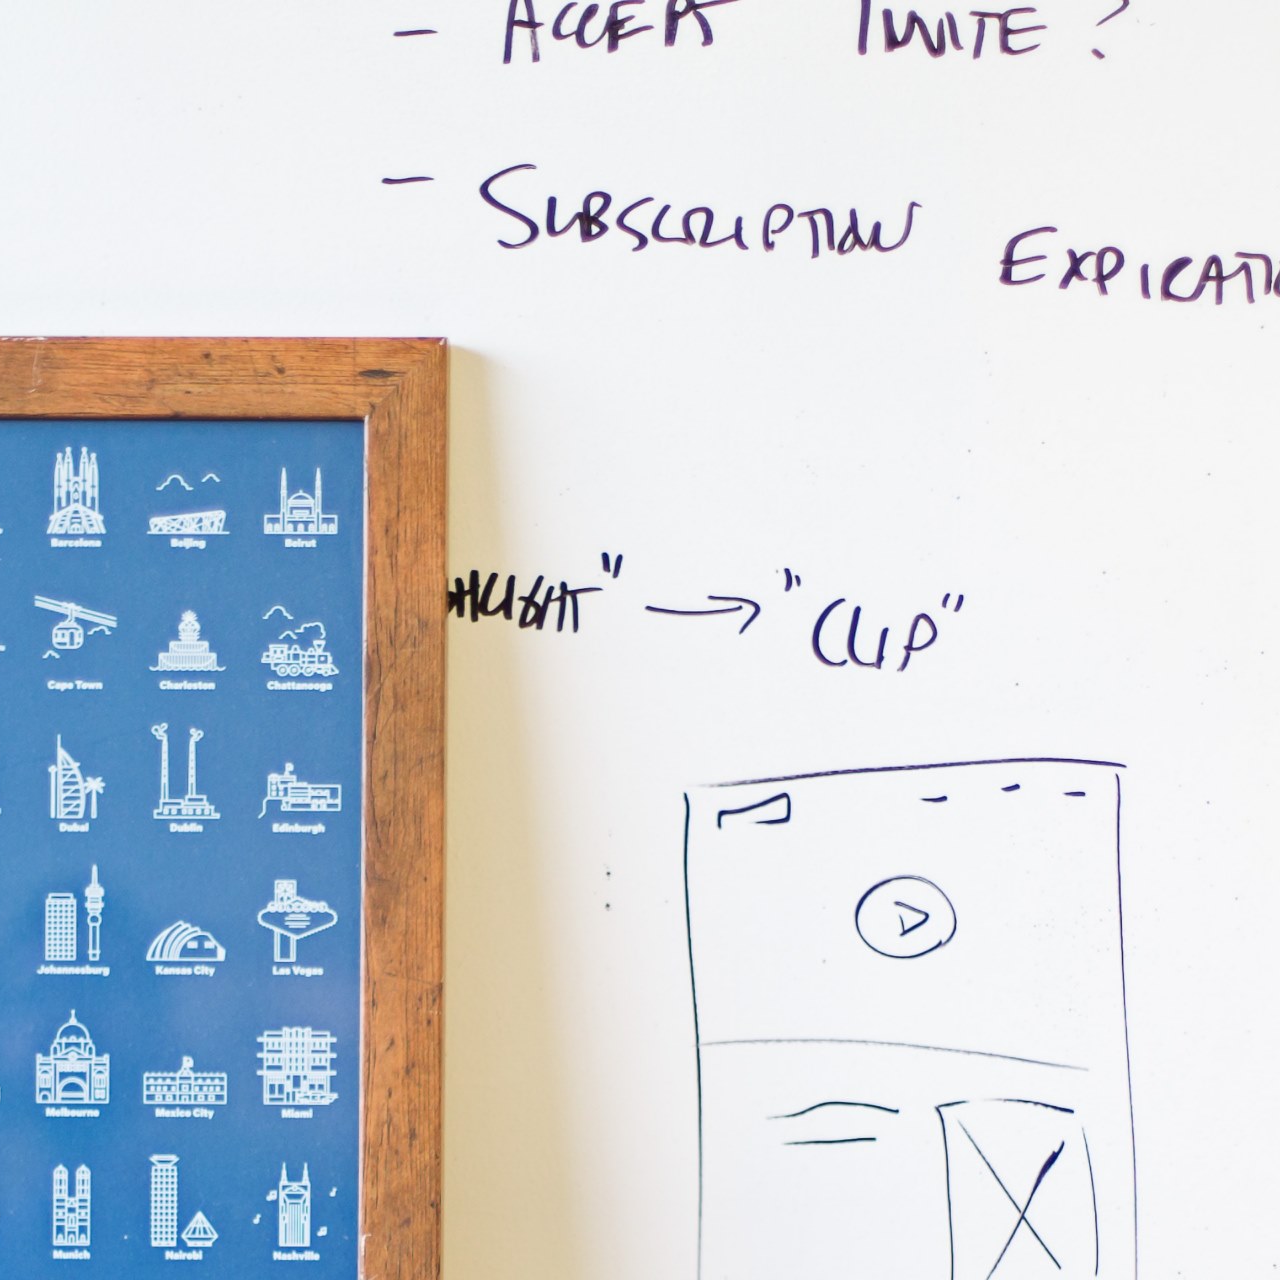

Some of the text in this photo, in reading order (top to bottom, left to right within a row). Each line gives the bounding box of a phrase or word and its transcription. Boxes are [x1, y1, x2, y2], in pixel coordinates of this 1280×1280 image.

[51, 538, 101, 547] Barcelona
[170, 538, 206, 549] Beijing
[285, 538, 316, 547] Beirut
[47, 680, 103, 691] Cape Town
[159, 680, 215, 690] Charleston
[267, 681, 332, 692] Chattanooga
[59, 822, 89, 832] Dubai
[170, 823, 203, 832] Dublin
[272, 823, 325, 834] Edinburgh
[37, 965, 110, 976] Johannesburg
[155, 965, 215, 977] Kansas City
[272, 966, 323, 977] Las Vegas
[45, 1107, 99, 1117] Melbourne
[155, 1107, 215, 1119] Mexico City
[281, 1109, 313, 1118] Miami
[53, 1250, 90, 1259] Munich
[165, 1250, 203, 1260] Nairobi
[273, 1251, 320, 1260] Nashville
